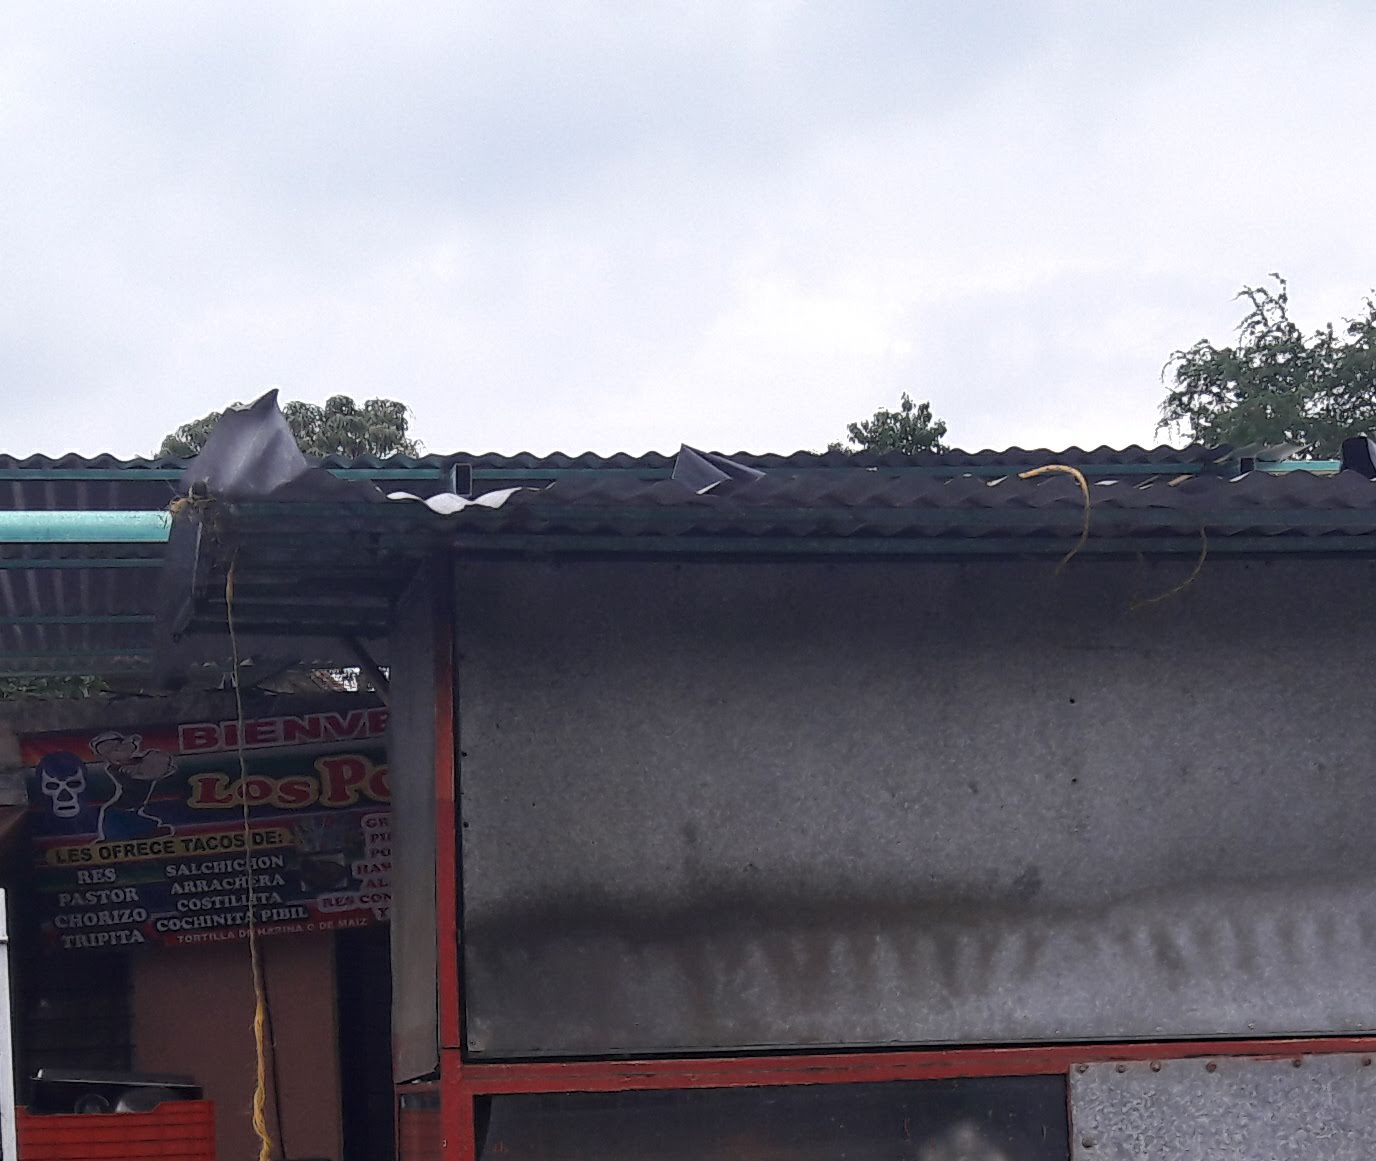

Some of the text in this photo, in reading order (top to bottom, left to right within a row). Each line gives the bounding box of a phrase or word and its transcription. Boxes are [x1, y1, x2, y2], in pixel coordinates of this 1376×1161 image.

[55, 830, 283, 863] LES OFRECE TACOS DE:
[77, 868, 117, 885] RES
[165, 855, 285, 878] SALCHICHON
[170, 873, 286, 896] ARRACHERA
[57, 887, 140, 907] PASTOR
[54, 908, 148, 929] CHORIZO
[156, 905, 309, 932] COCHINITA PIBIL
[63, 929, 146, 949] TRIPITA
[177, 931, 235, 944] TORTILLA
